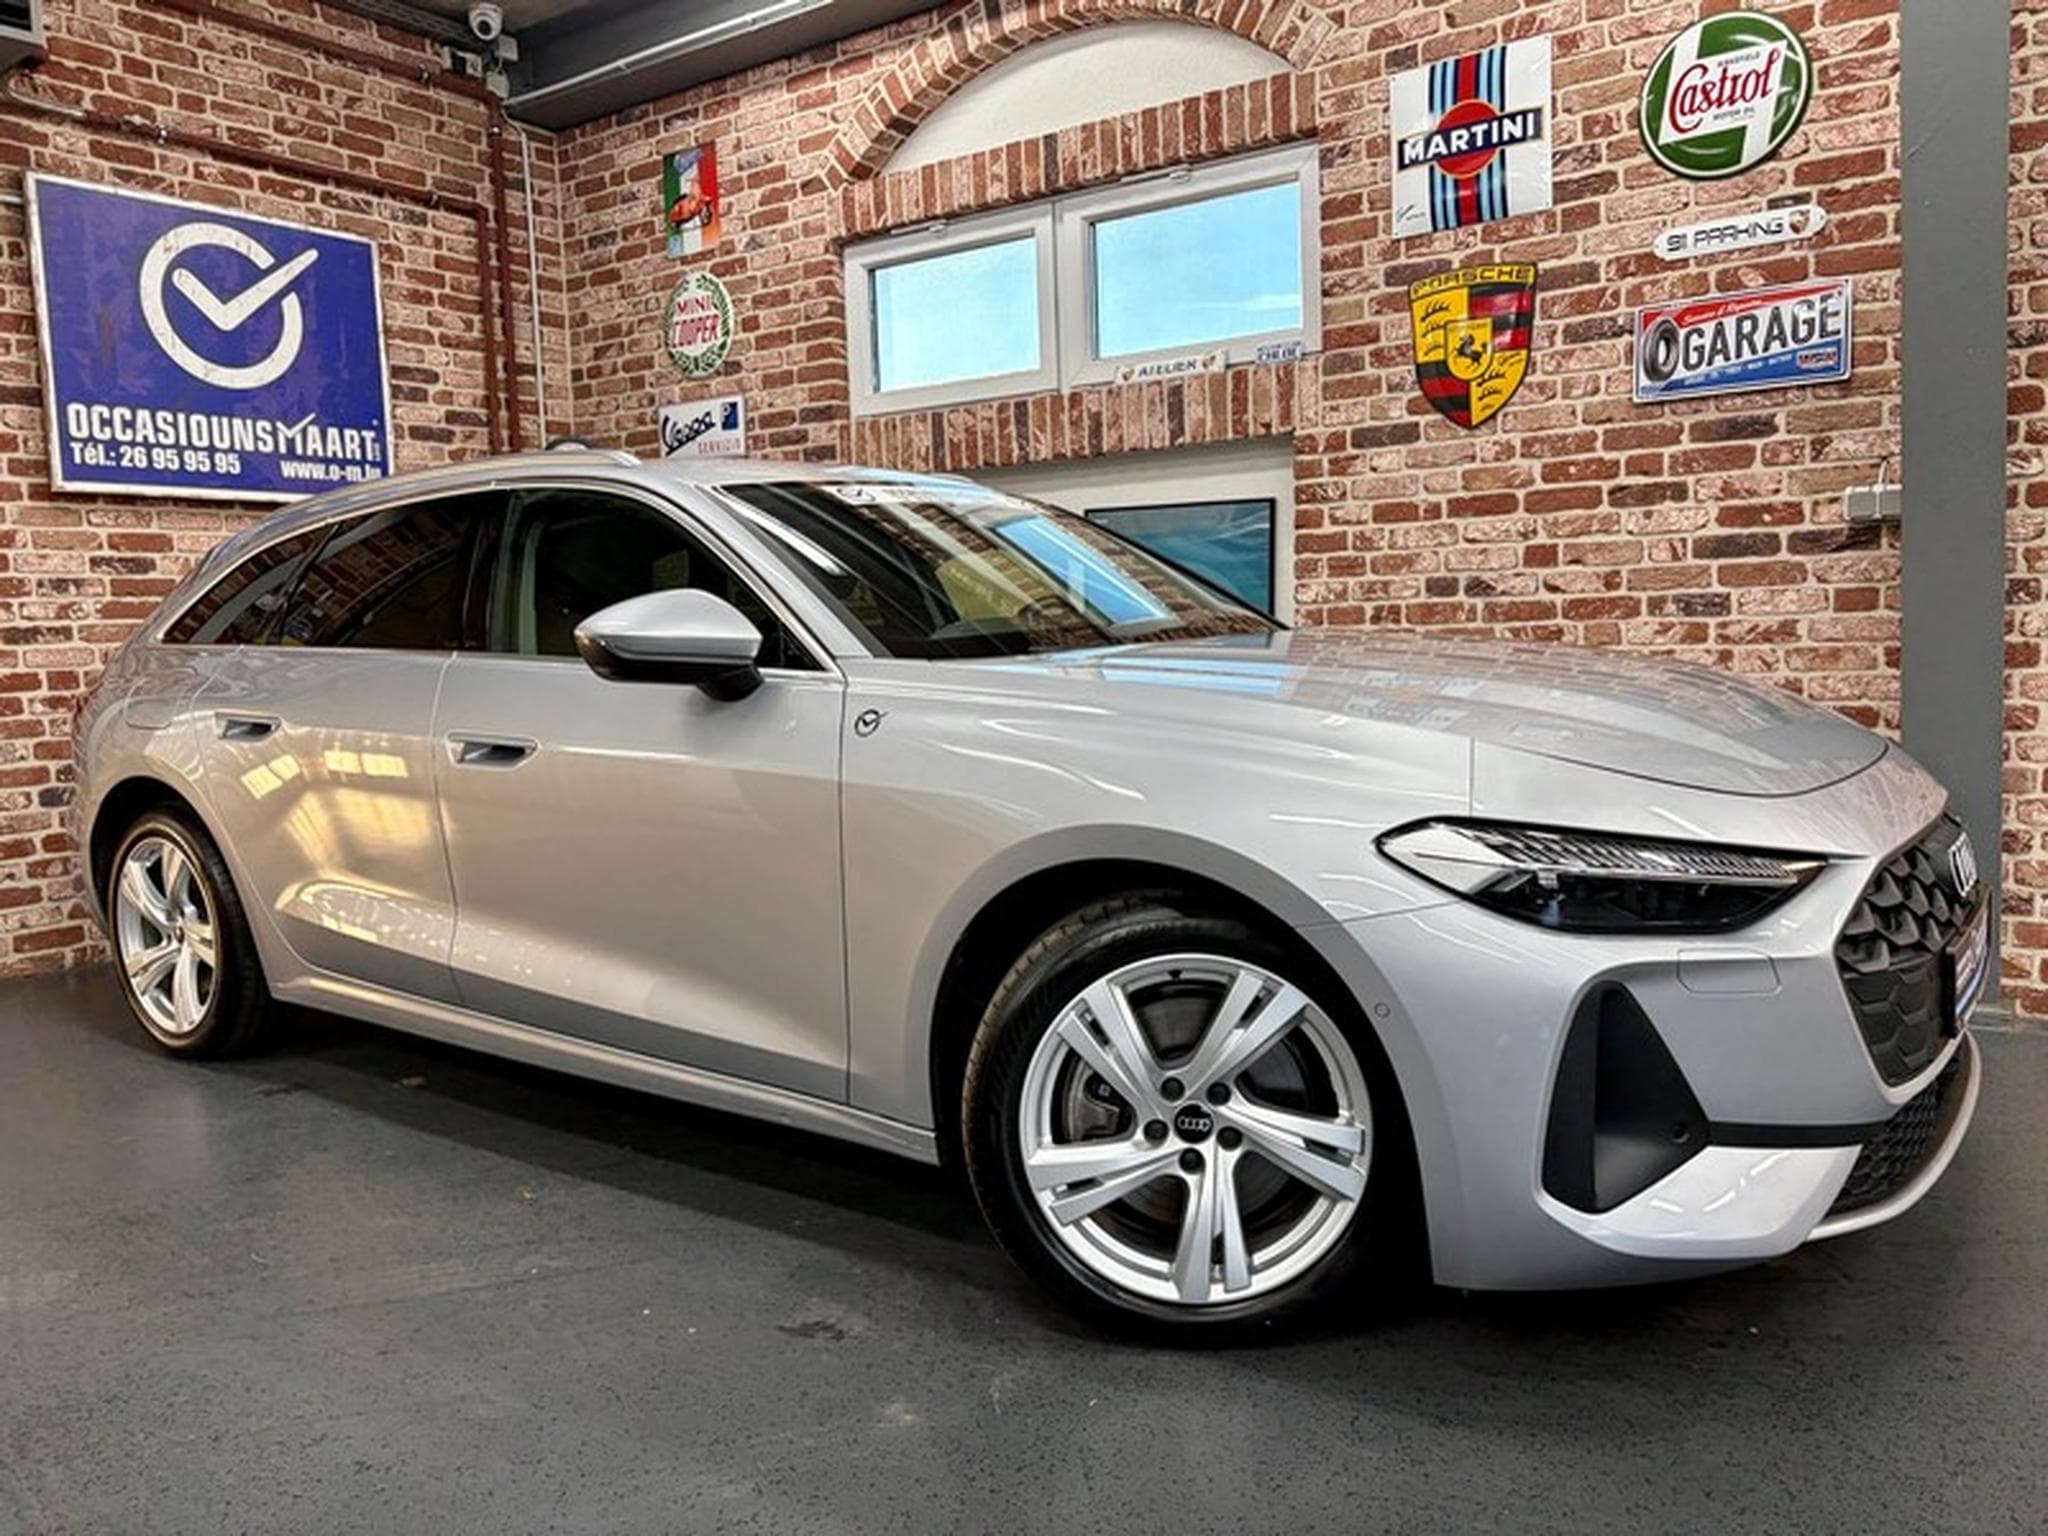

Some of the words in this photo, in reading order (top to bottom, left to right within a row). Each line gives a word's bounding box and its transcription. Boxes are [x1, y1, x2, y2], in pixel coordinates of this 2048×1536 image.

[1669, 48, 1781, 133] Castrol
[1404, 112, 1534, 165] MARTINI
[1411, 264, 1535, 300] PORSCHE
[671, 314, 719, 349] COOPER
[1681, 293, 1841, 372] GARAGE
[66, 402, 376, 462] OCCASIOUNSMAART
[662, 411, 716, 456] Vespa
[119, 444, 148, 469] 26
[152, 446, 180, 471] 95
[184, 449, 212, 473] 95
[214, 452, 241, 475] 95
